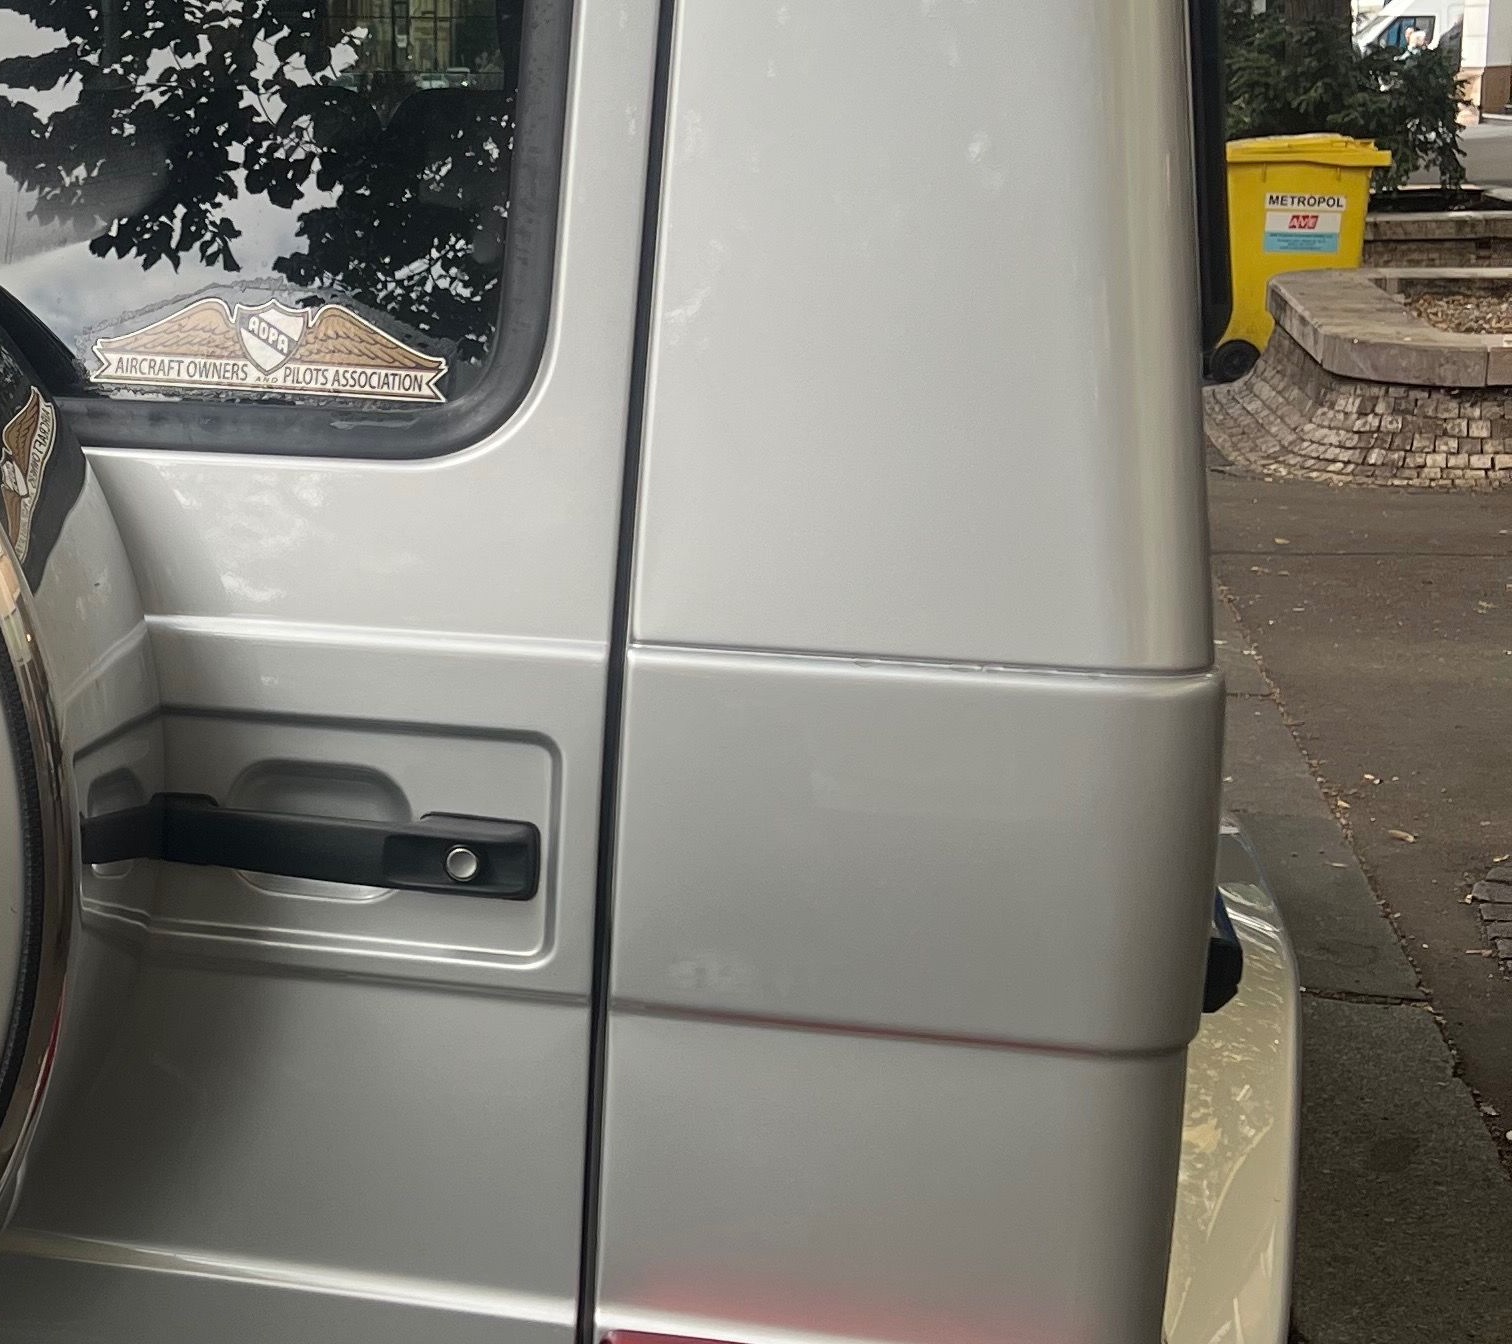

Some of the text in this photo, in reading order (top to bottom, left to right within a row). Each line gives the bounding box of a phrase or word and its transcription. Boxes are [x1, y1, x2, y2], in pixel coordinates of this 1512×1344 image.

[1268, 194, 1344, 208] METROPOL
[248, 316, 289, 354] AOPA
[114, 356, 424, 393] AIRCRAFT OWNERS AND PILOTS ASSOCIATION
